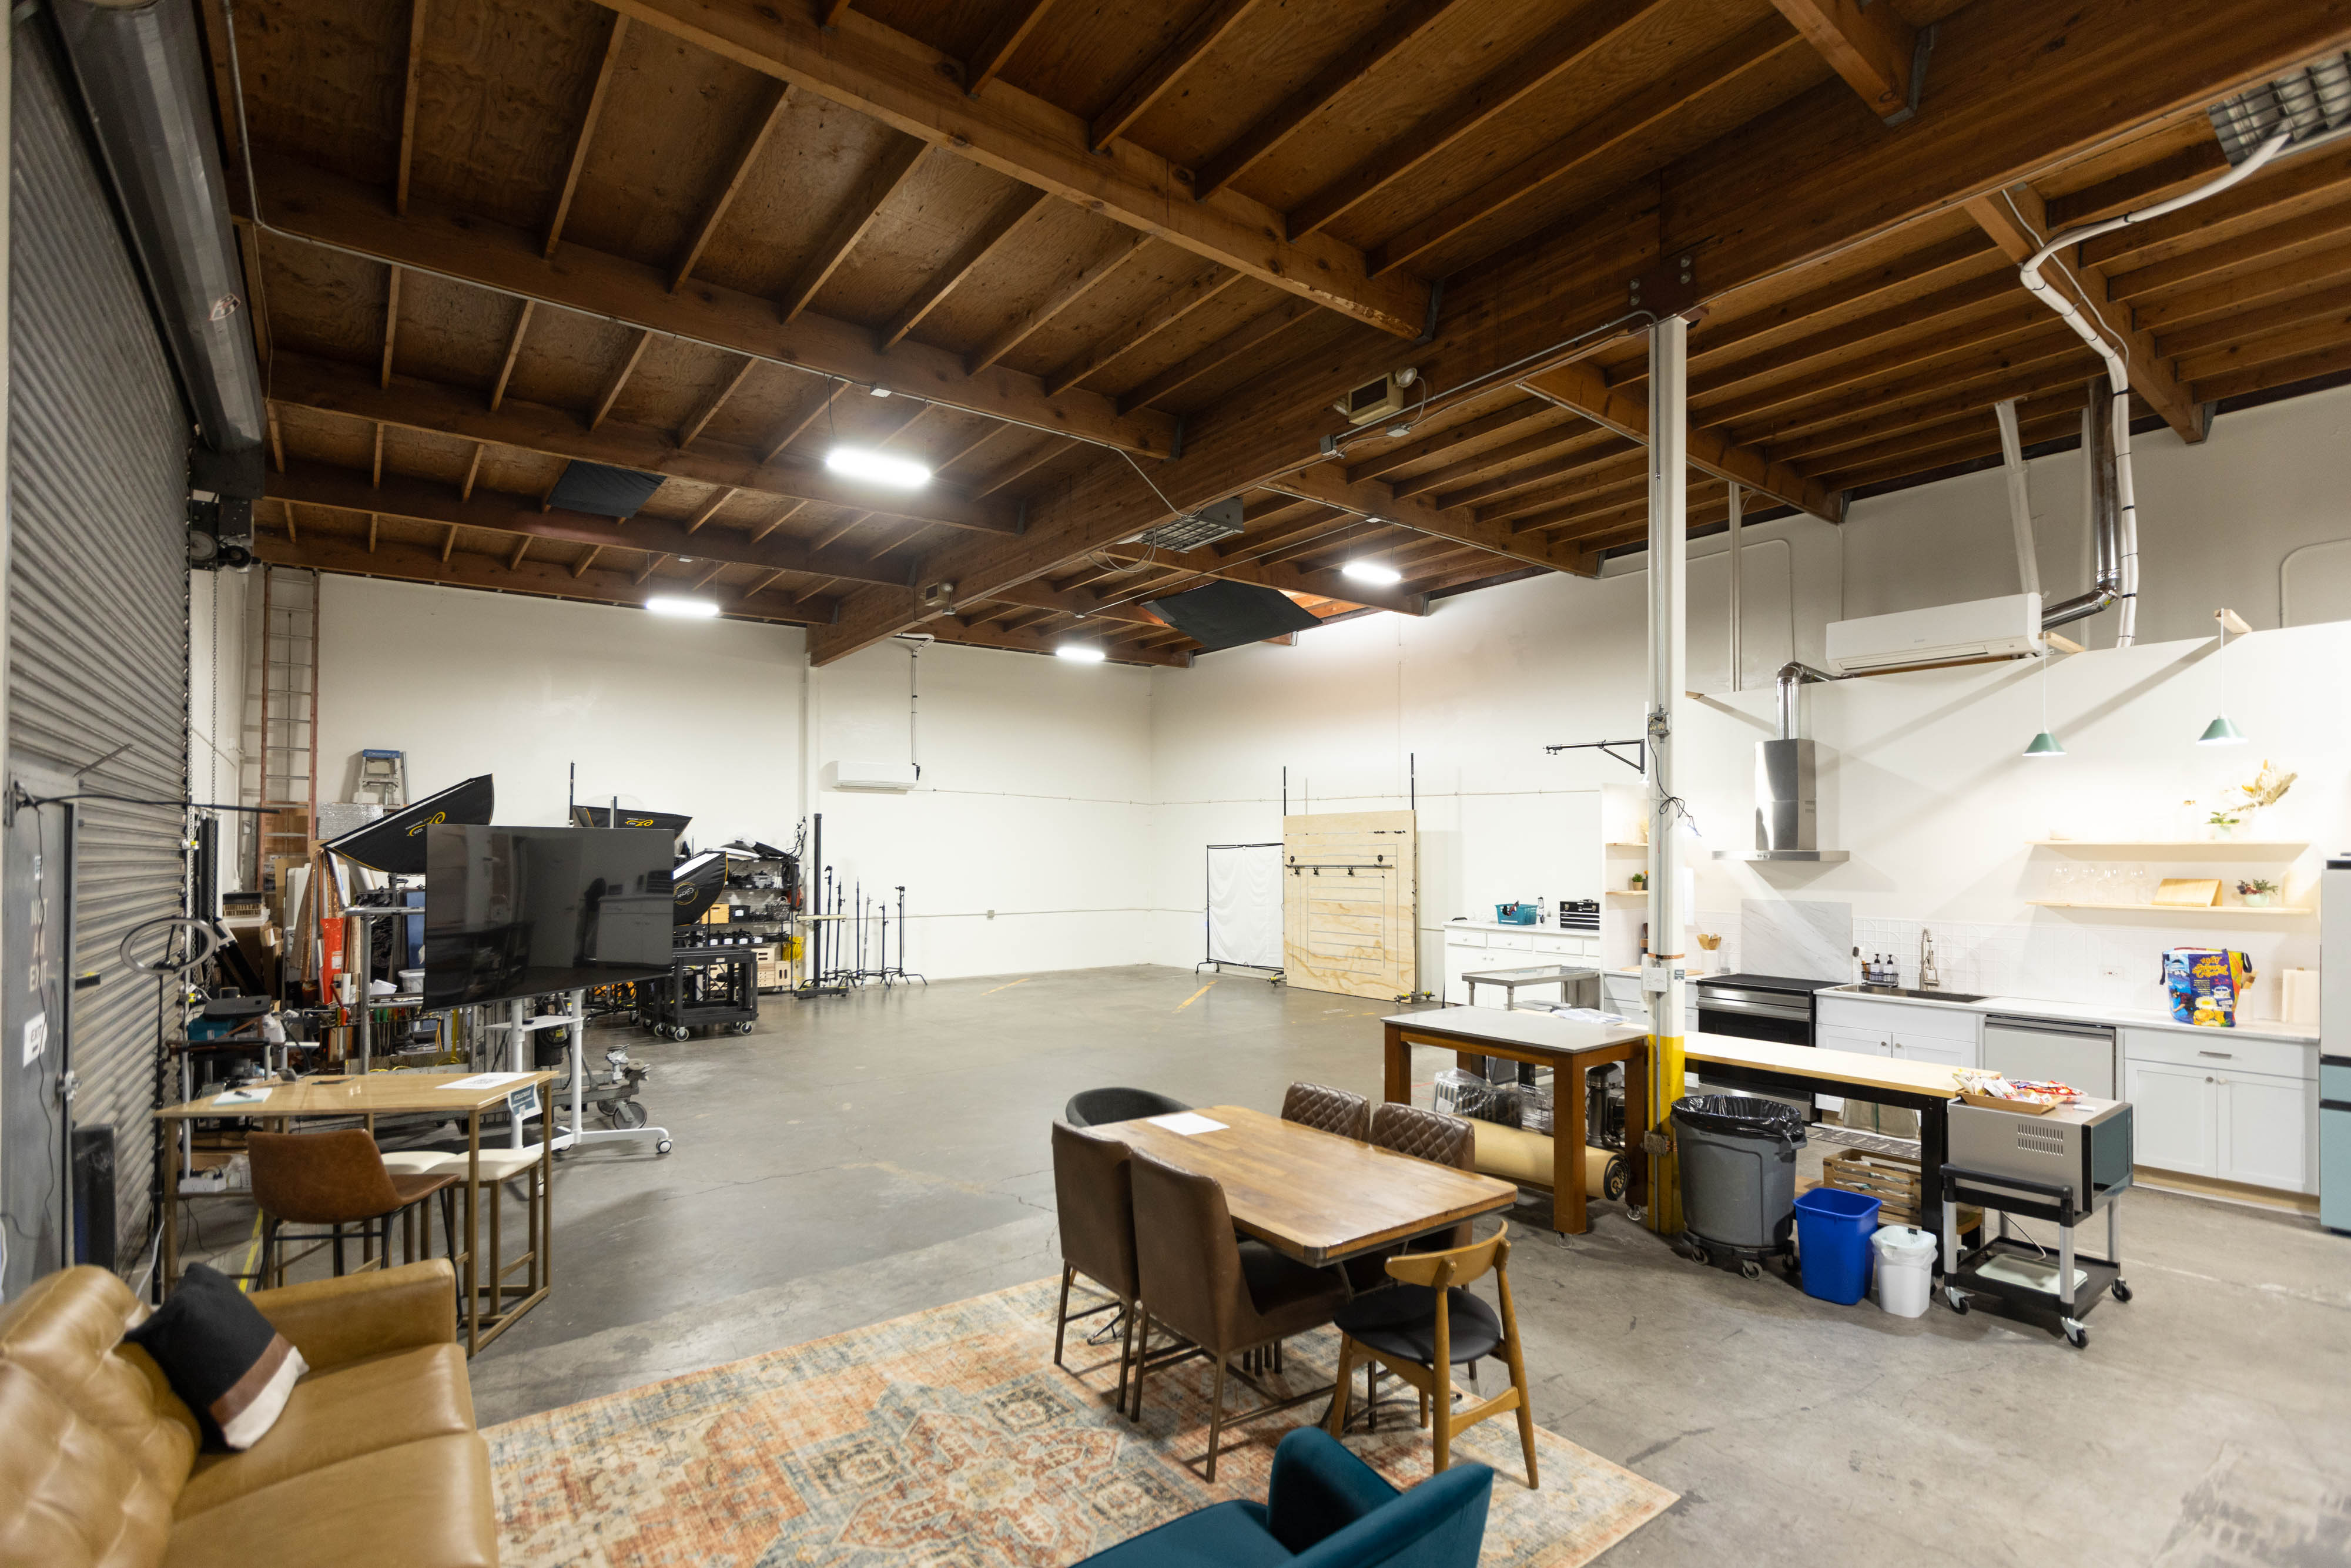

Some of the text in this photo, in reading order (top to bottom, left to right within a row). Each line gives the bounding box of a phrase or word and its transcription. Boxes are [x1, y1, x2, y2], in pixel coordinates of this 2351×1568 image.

[677, 887, 694, 899] Glow
[31, 898, 49, 926] NOT
[30, 960, 48, 992] EXIT
